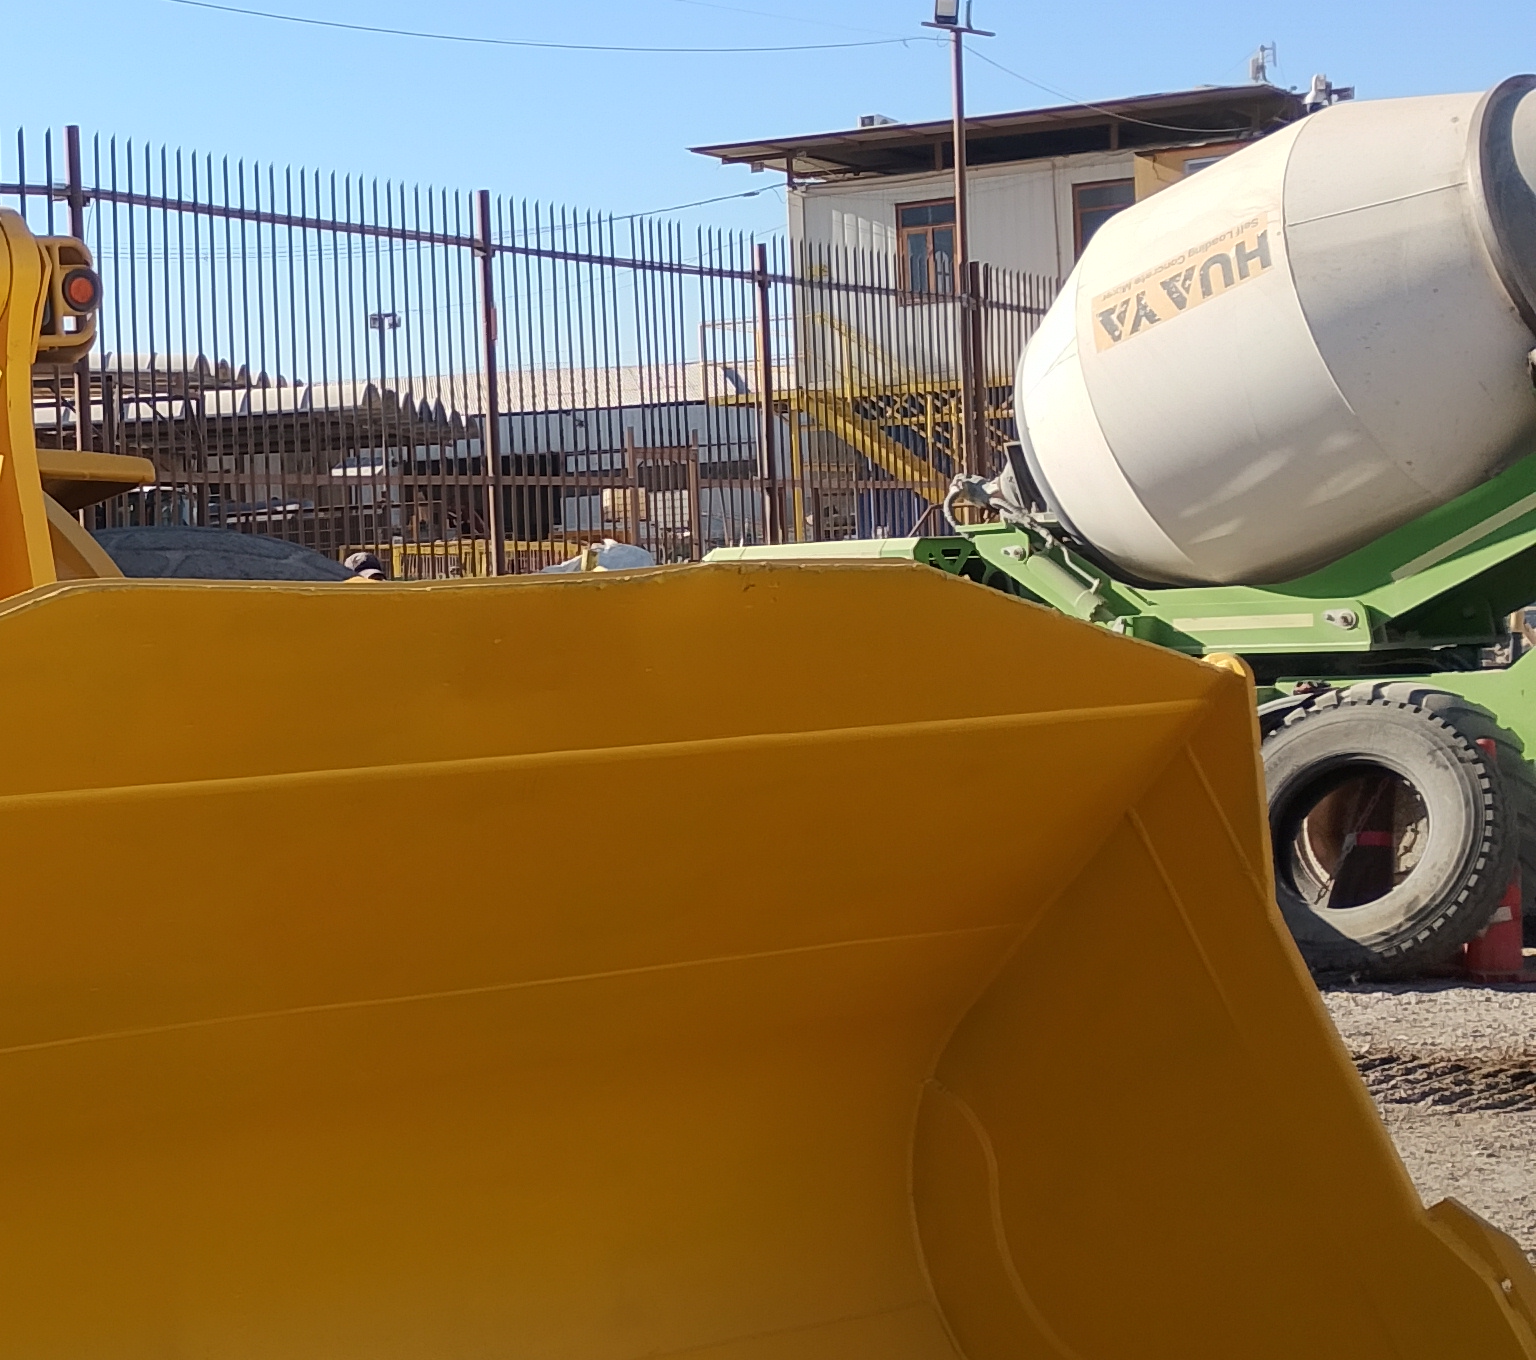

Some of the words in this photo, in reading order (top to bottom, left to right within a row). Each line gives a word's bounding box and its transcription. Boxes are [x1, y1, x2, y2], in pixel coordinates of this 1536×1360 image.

[1233, 217, 1260, 238] Self
[1187, 230, 1234, 259] Loading
[1133, 255, 1187, 286] Concrete
